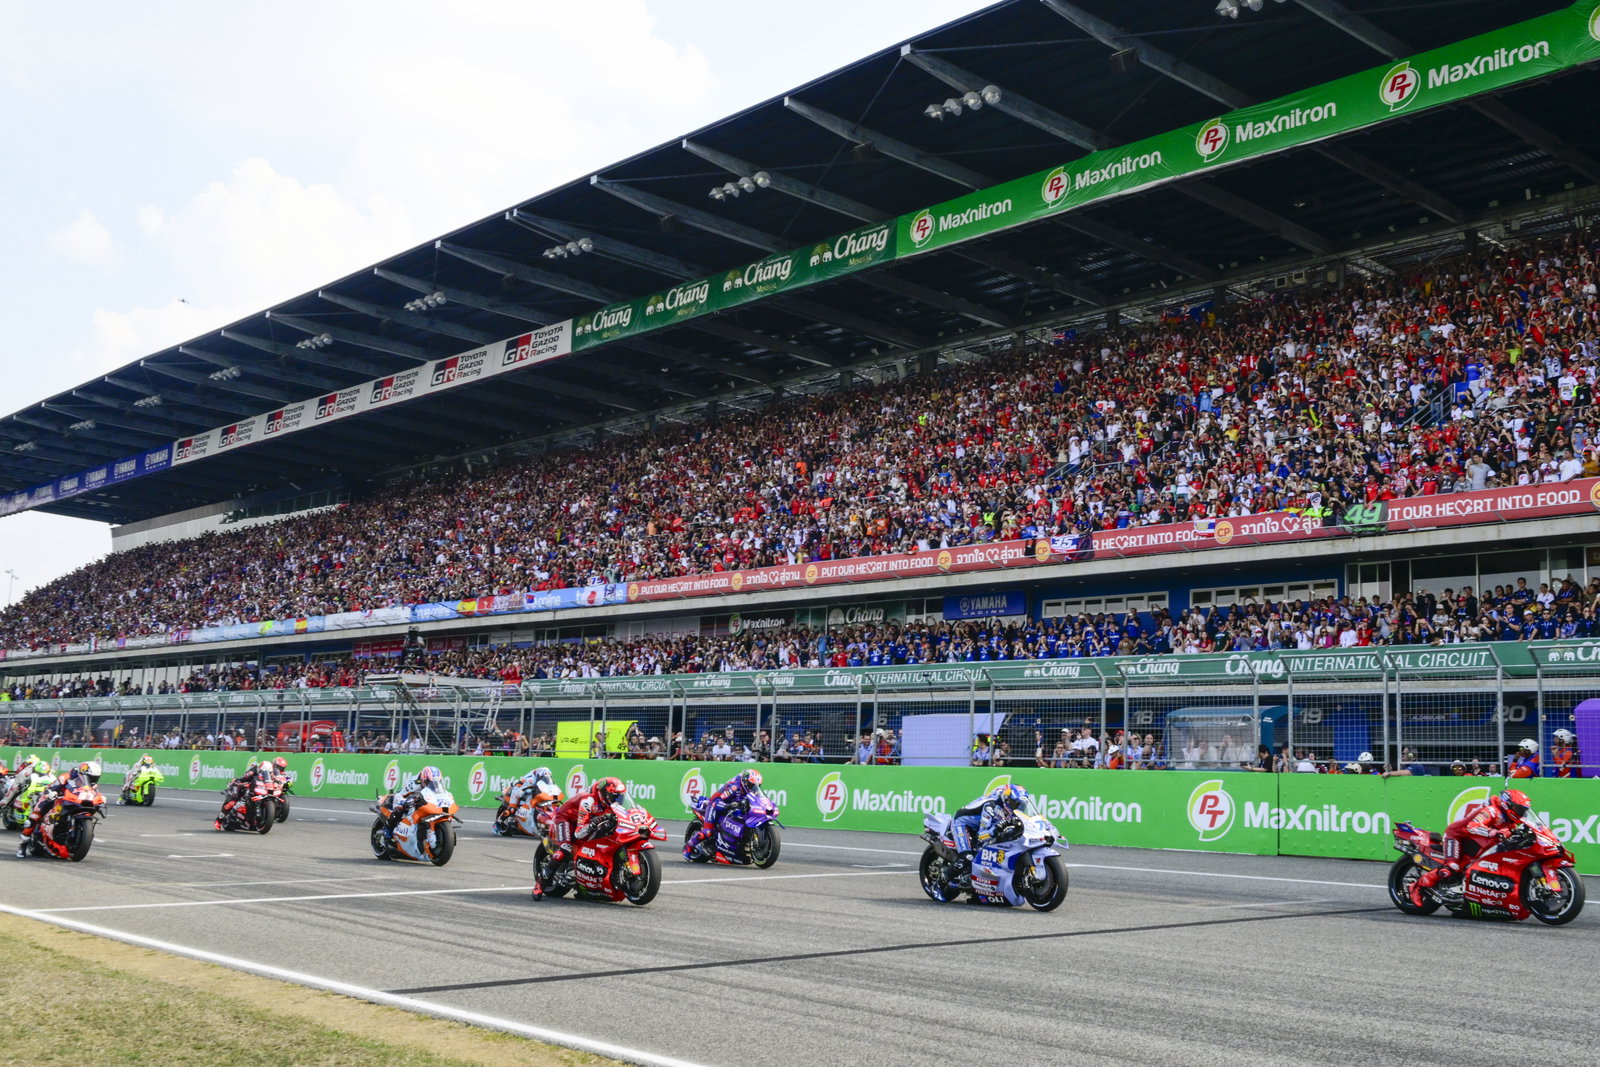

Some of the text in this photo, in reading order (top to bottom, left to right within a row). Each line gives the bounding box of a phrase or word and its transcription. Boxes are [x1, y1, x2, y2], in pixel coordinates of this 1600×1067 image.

[1428, 40, 1549, 90] Maxnitron
[1235, 102, 1337, 144] Maxnitron
[1074, 150, 1162, 190] Maxnitron
[938, 198, 1012, 232] Maxnitron
[834, 228, 889, 259] Chang
[744, 258, 792, 287] Chang
[666, 281, 710, 310] Chang
[592, 305, 632, 332] Chang
[533, 326, 564, 340] TOYOTA
[532, 335, 560, 348] GAZOO
[460, 350, 488, 363] TOYOTA
[502, 343, 530, 366] GR
[530, 342, 558, 358] Racing
[457, 366, 482, 380] Racing
[458, 360, 484, 372] GAZOO
[394, 371, 419, 382] TOYOTA
[431, 364, 457, 387] GR
[394, 378, 416, 391] GAZOO
[370, 382, 392, 404] GR
[1404, 504, 1432, 519] OUR
[1498, 494, 1532, 510] INTO
[1537, 490, 1580, 506] FOOD
[1217, 528, 1230, 537] CP
[1241, 517, 1279, 535] จากใจ
[1146, 532, 1173, 546] INTO
[822, 567, 837, 577] PUT
[838, 565, 856, 576] OUR
[890, 560, 909, 570] INTO
[910, 556, 934, 569] FOOD
[642, 584, 654, 594] PUT
[654, 584, 668, 594] OUR
[694, 580, 710, 590] INTO
[710, 578, 728, 588] FOOD
[970, 595, 1007, 610] YAMAHA
[744, 617, 785, 629] Maxnitron
[846, 607, 885, 626] Chang
[1042, 662, 1080, 678] Chang
[1136, 658, 1180, 676] Chang
[1225, 651, 1490, 679] Chang INTERNATIONAL CIRCUIT
[824, 670, 862, 687] Chang
[1133, 710, 1154, 725] 18
[1300, 708, 1322, 724] 19
[1490, 706, 1526, 722] 20
[326, 769, 369, 785] Maxnitron
[852, 788, 946, 815] Maxnitron
[1244, 802, 1391, 835] Maxnitron
[576, 859, 604, 875] Lenovo
[1472, 874, 1510, 890] Lenovo
[1476, 888, 1507, 898] NetApp
